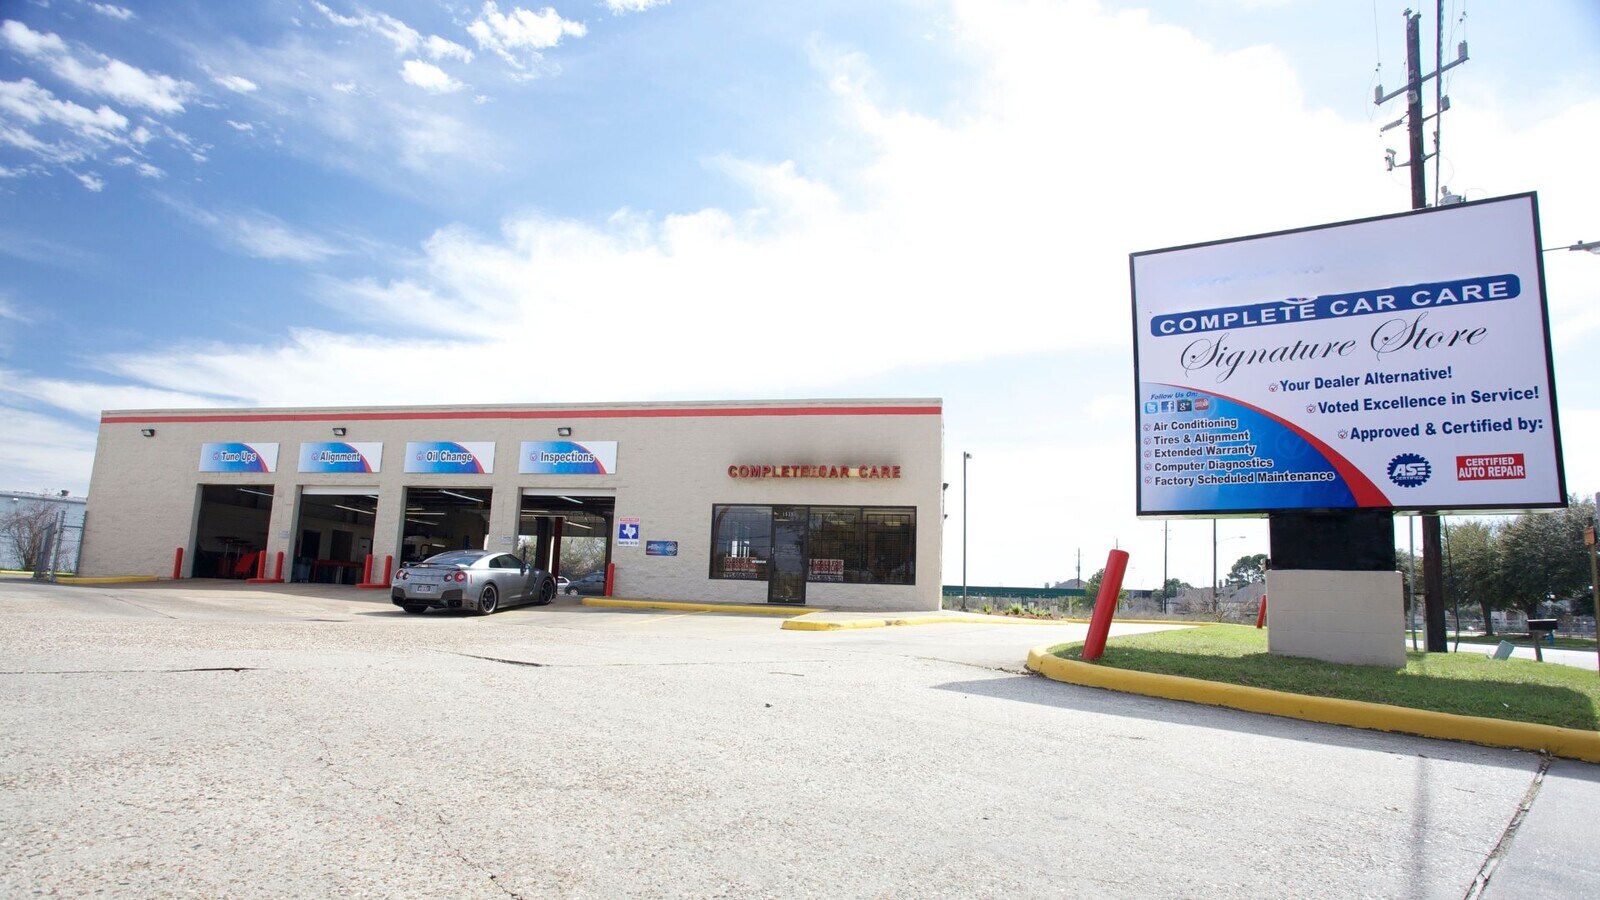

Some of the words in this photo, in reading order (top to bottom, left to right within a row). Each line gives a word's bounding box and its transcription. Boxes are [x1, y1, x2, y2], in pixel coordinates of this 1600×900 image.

[1159, 303, 1316, 334] COMPLETE
[1329, 294, 1396, 316] CAR
[1411, 280, 1510, 306] CARE
[1180, 332, 1357, 384] Signature
[1370, 311, 1488, 361] Store
[1279, 379, 1310, 392] Your
[1314, 374, 1360, 390] Dealer
[1364, 366, 1453, 386] Alternative!
[1318, 399, 1359, 414] Voted
[1363, 393, 1447, 411] Excellence
[1451, 391, 1467, 405] in
[1471, 386, 1539, 403] Service!
[1153, 422, 1168, 431] Air
[1171, 418, 1237, 431] Conditioning
[1350, 424, 1420, 443] Approved
[1425, 421, 1437, 436] &
[1441, 417, 1512, 434] Certified
[1517, 416, 1544, 432] by:
[1154, 436, 1180, 445] Tires
[1183, 434, 1191, 444] &
[1194, 431, 1249, 444] Alignment
[221, 452, 240, 461] Tune
[241, 451, 257, 463] Ups
[319, 451, 361, 463] Alignment
[426, 451, 438, 461] Oil
[440, 451, 472, 464] Change
[1154, 447, 1203, 458] Extended
[1205, 444, 1256, 456] Warranty
[540, 452, 594, 465] Inspections
[1465, 457, 1515, 467] CERTIFIED
[727, 465, 811, 478] COMPLETE
[818, 465, 850, 478] CAR
[858, 465, 902, 478] CARE
[1154, 461, 1205, 473] Computer
[1208, 459, 1273, 471] Diagnostics
[1392, 463, 1427, 477] ASE
[1458, 467, 1485, 478] AUTO
[1488, 465, 1525, 477] REPAIR
[1155, 475, 1194, 487] Factory
[1197, 472, 1254, 485] Scheduled
[1257, 471, 1334, 483] Maintenance
